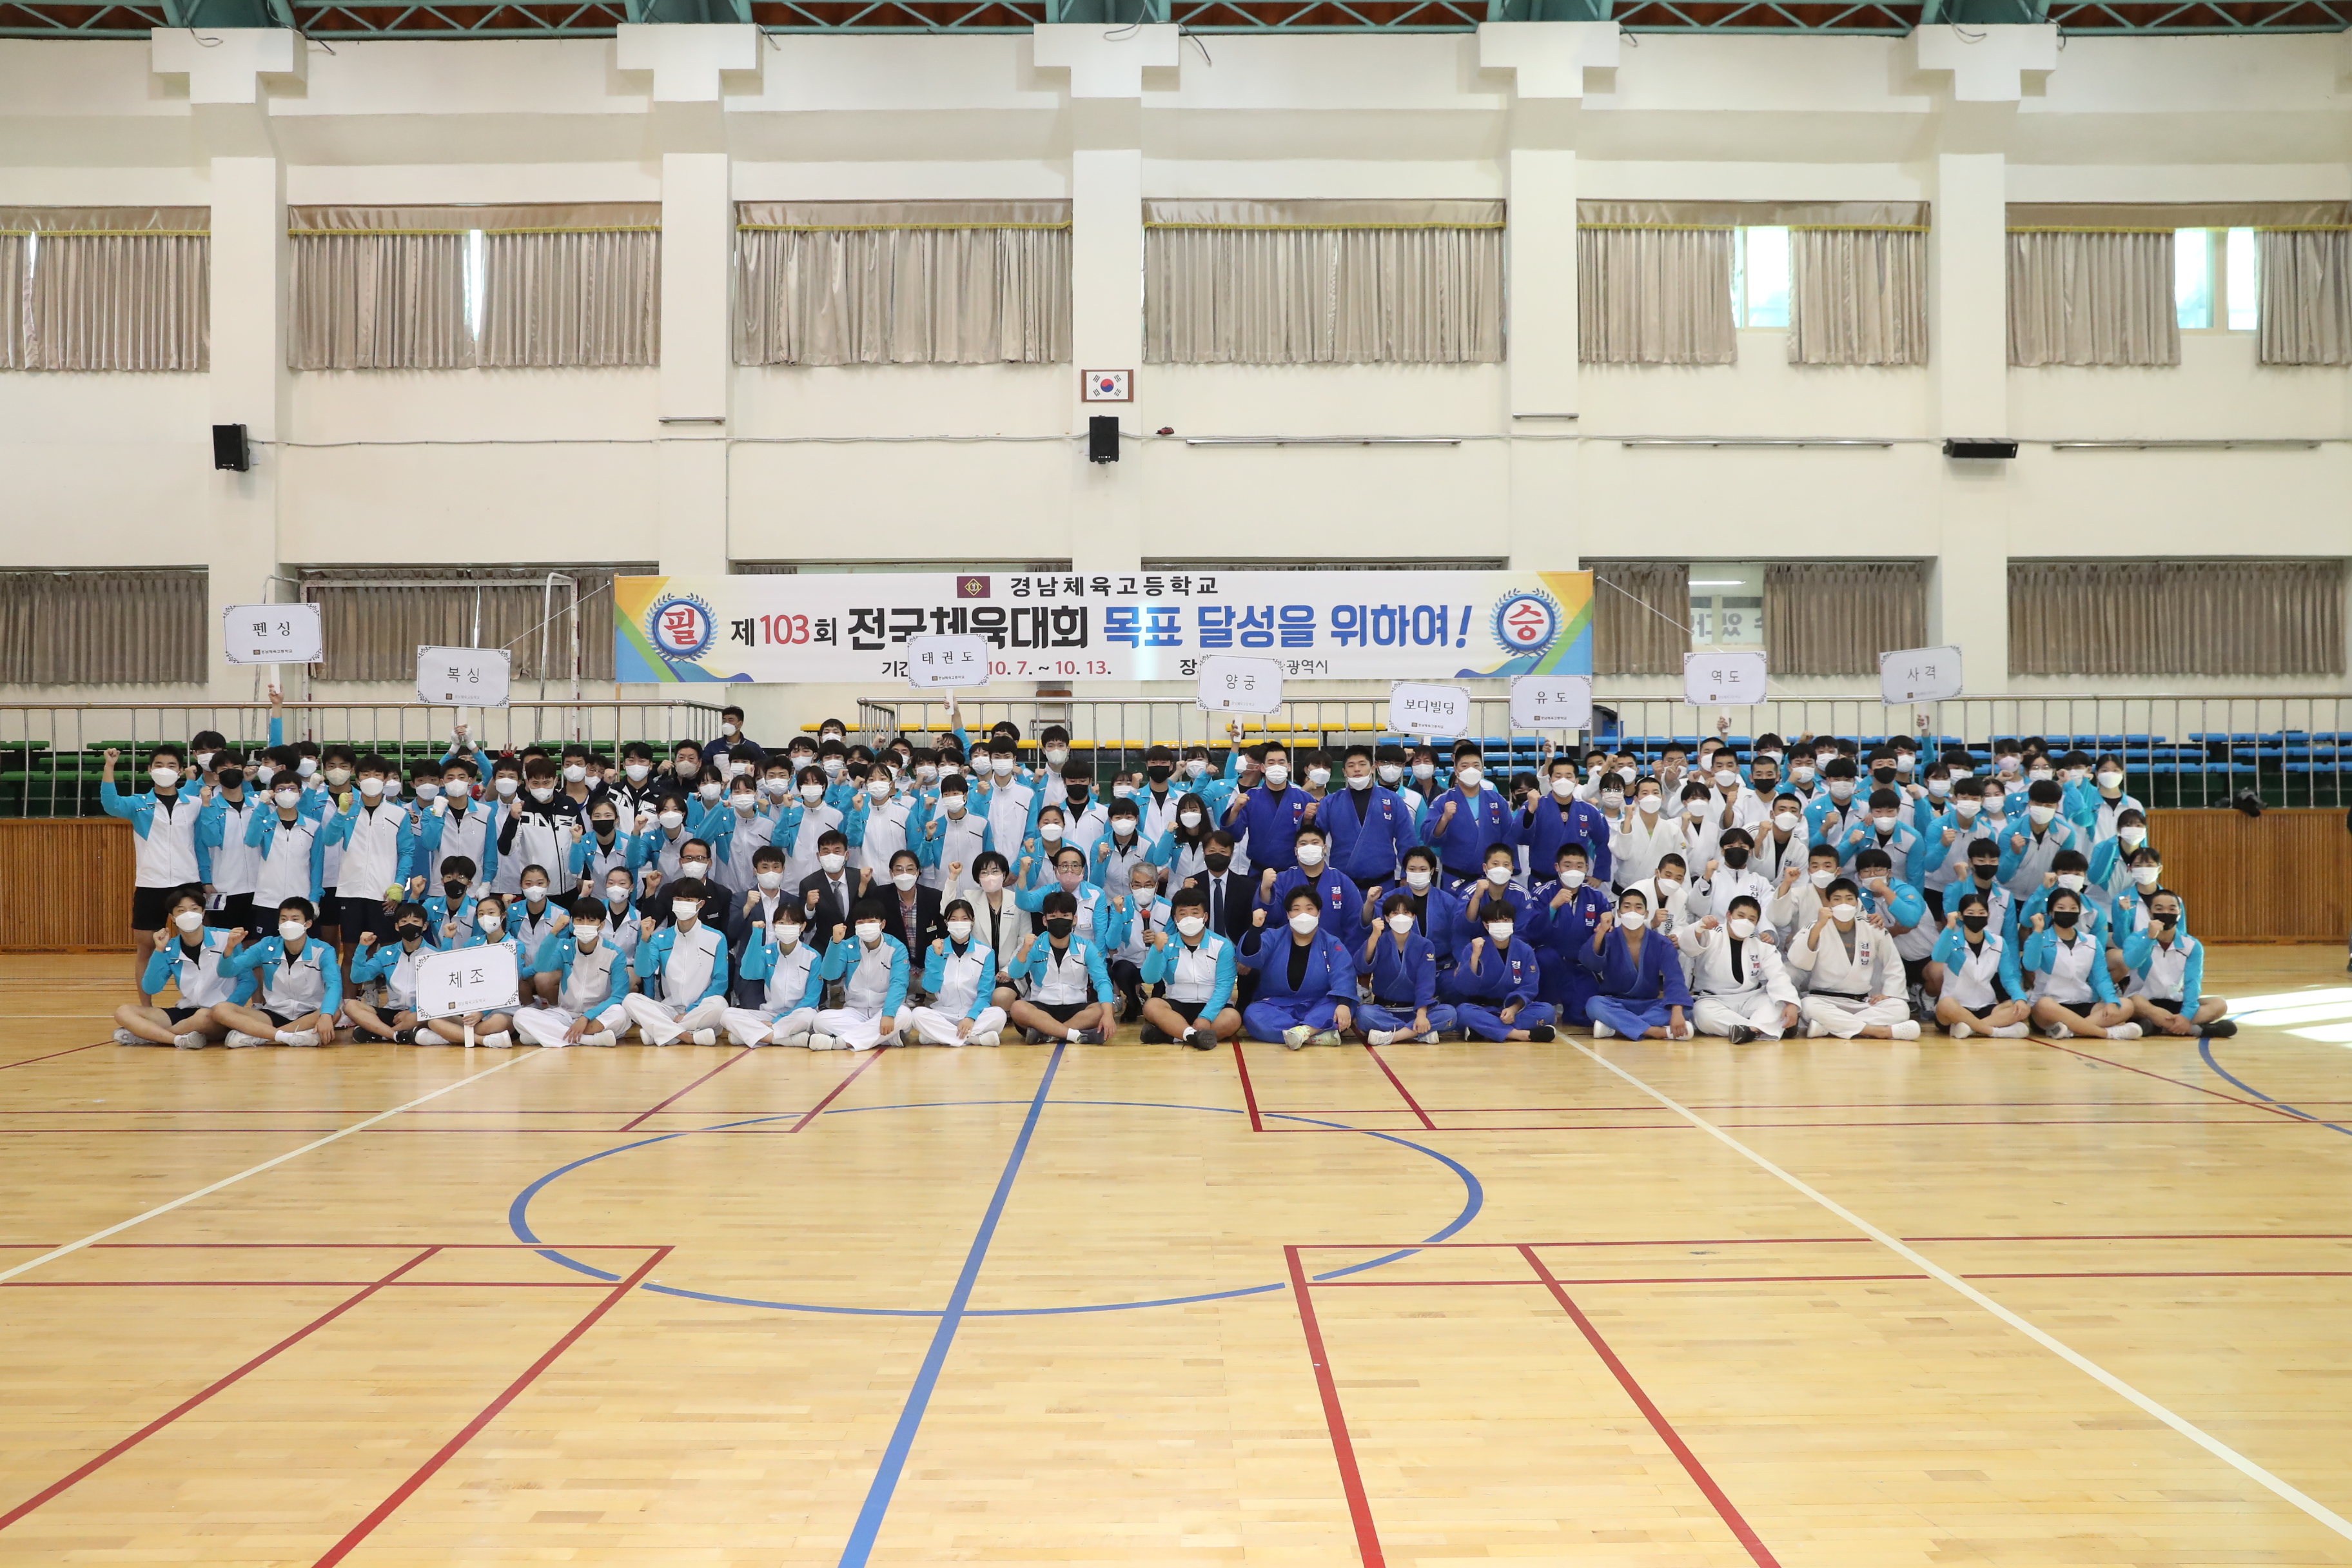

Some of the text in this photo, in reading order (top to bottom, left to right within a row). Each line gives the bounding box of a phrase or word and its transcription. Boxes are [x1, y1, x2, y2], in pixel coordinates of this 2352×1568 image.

[1010, 576, 1219, 597] 경남체육고등학교
[664, 608, 697, 645] 필
[847, 605, 1088, 651] 전국체육대회
[1103, 604, 1183, 649] 목표
[1198, 604, 1317, 649] 달성을
[1331, 603, 1473, 649] 위하여!
[1509, 603, 1546, 642] 승
[921, 651, 974, 665] 태권도
[1016, 660, 1033, 676] 7.
[1054, 660, 1081, 676] 10.
[1086, 660, 1112, 676] 13.
[1404, 699, 1454, 715] 보디빌딩
